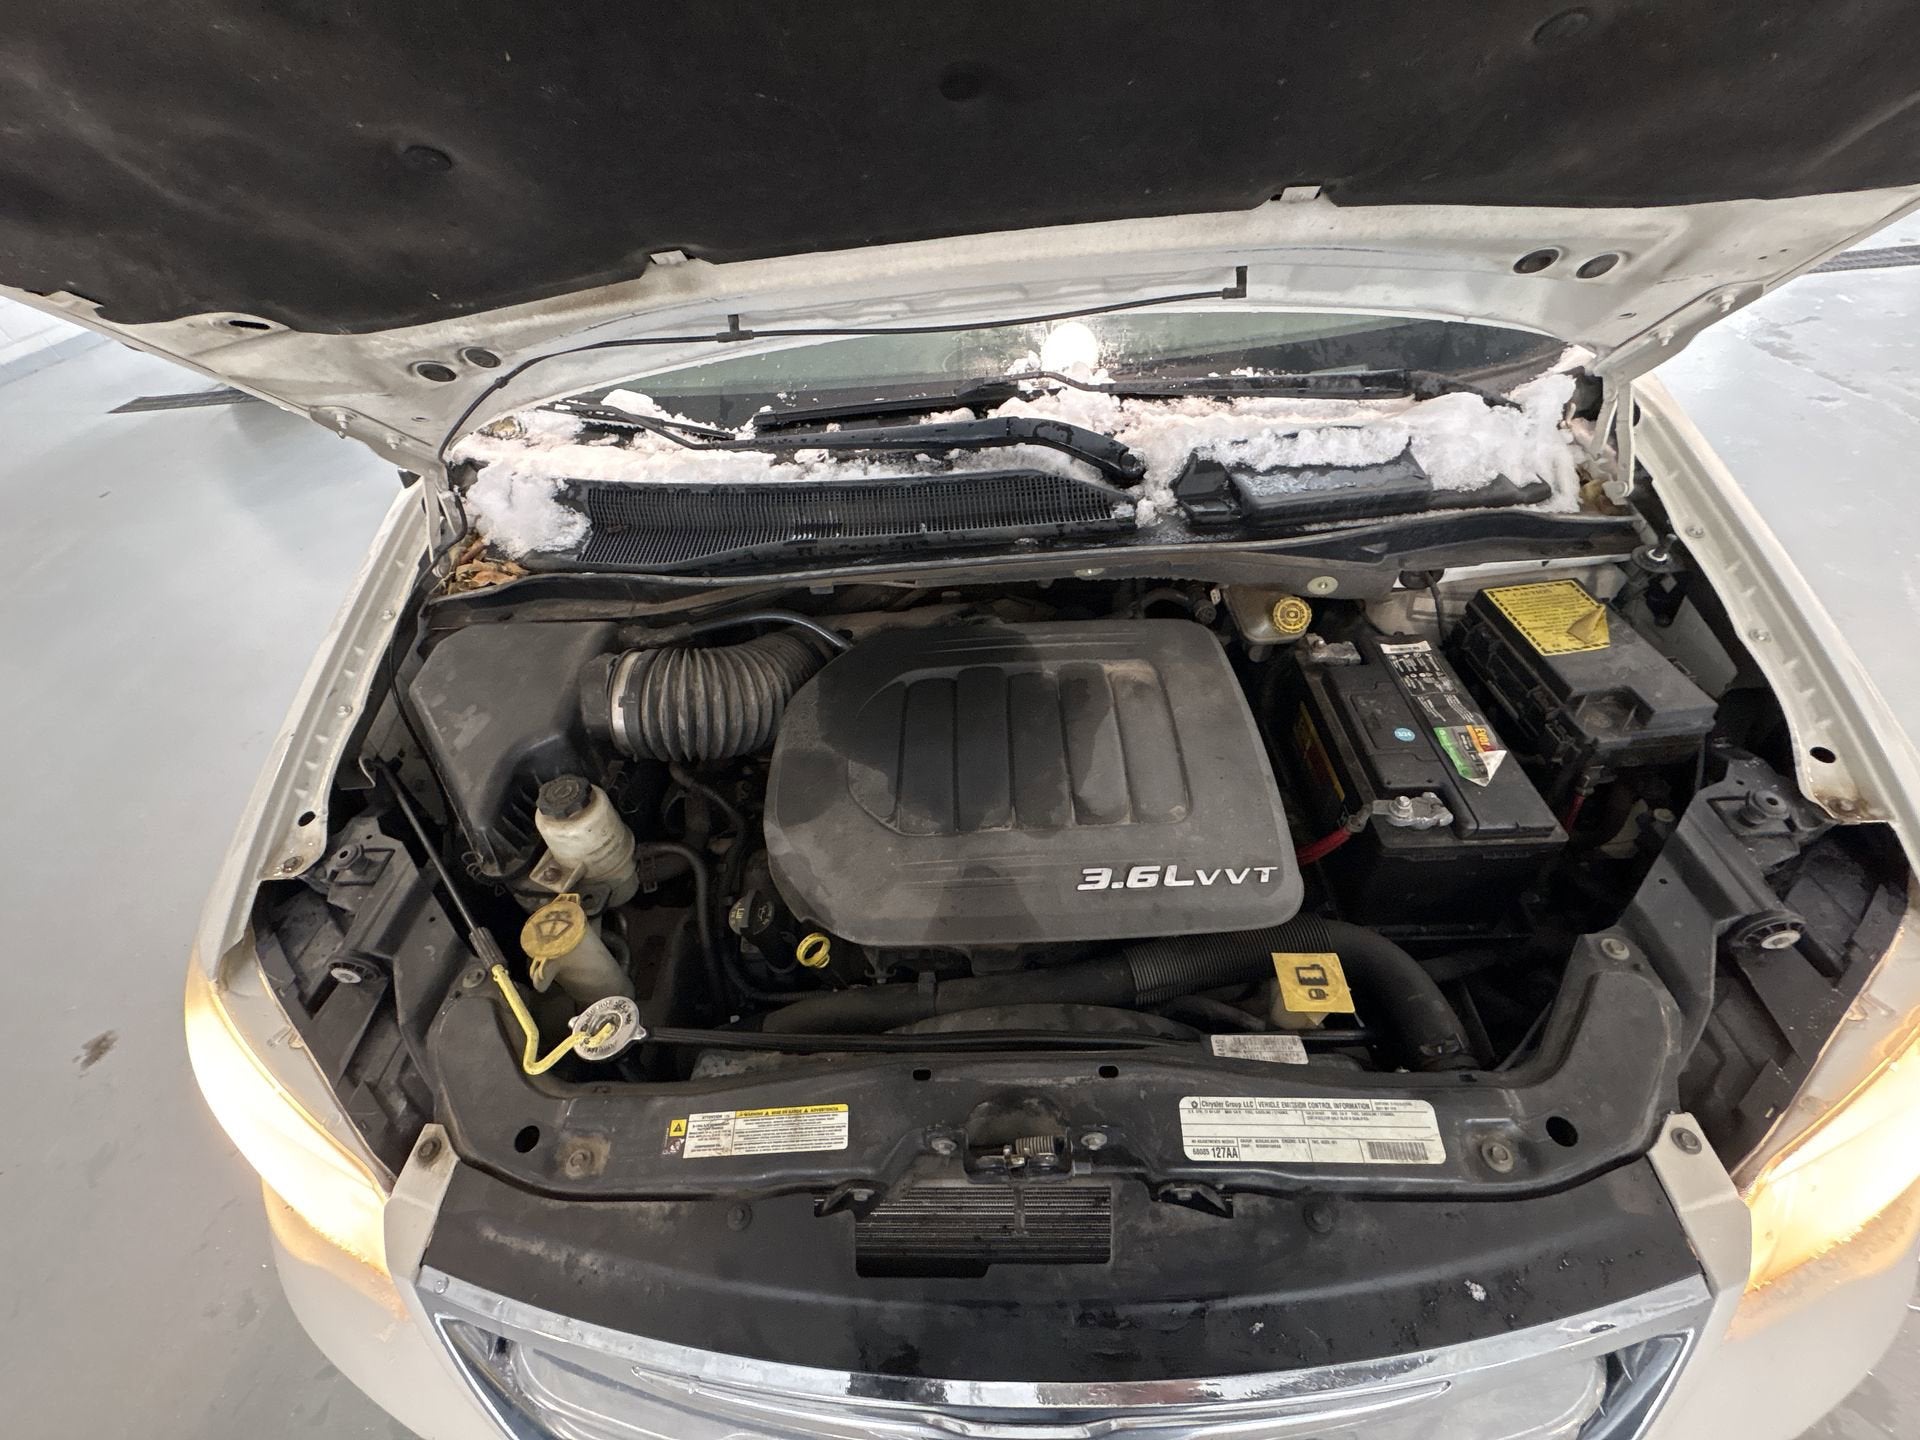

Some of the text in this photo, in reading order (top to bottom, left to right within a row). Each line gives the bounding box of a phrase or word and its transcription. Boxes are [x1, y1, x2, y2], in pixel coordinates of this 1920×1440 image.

[1201, 1100, 1224, 1109] Chrysler
[1225, 1100, 1242, 1109] Group
[1258, 1101, 1280, 1109] VEHICLE
[1333, 1102, 1370, 1110] INFORMATION
[1211, 1147, 1239, 1159] 127AA
